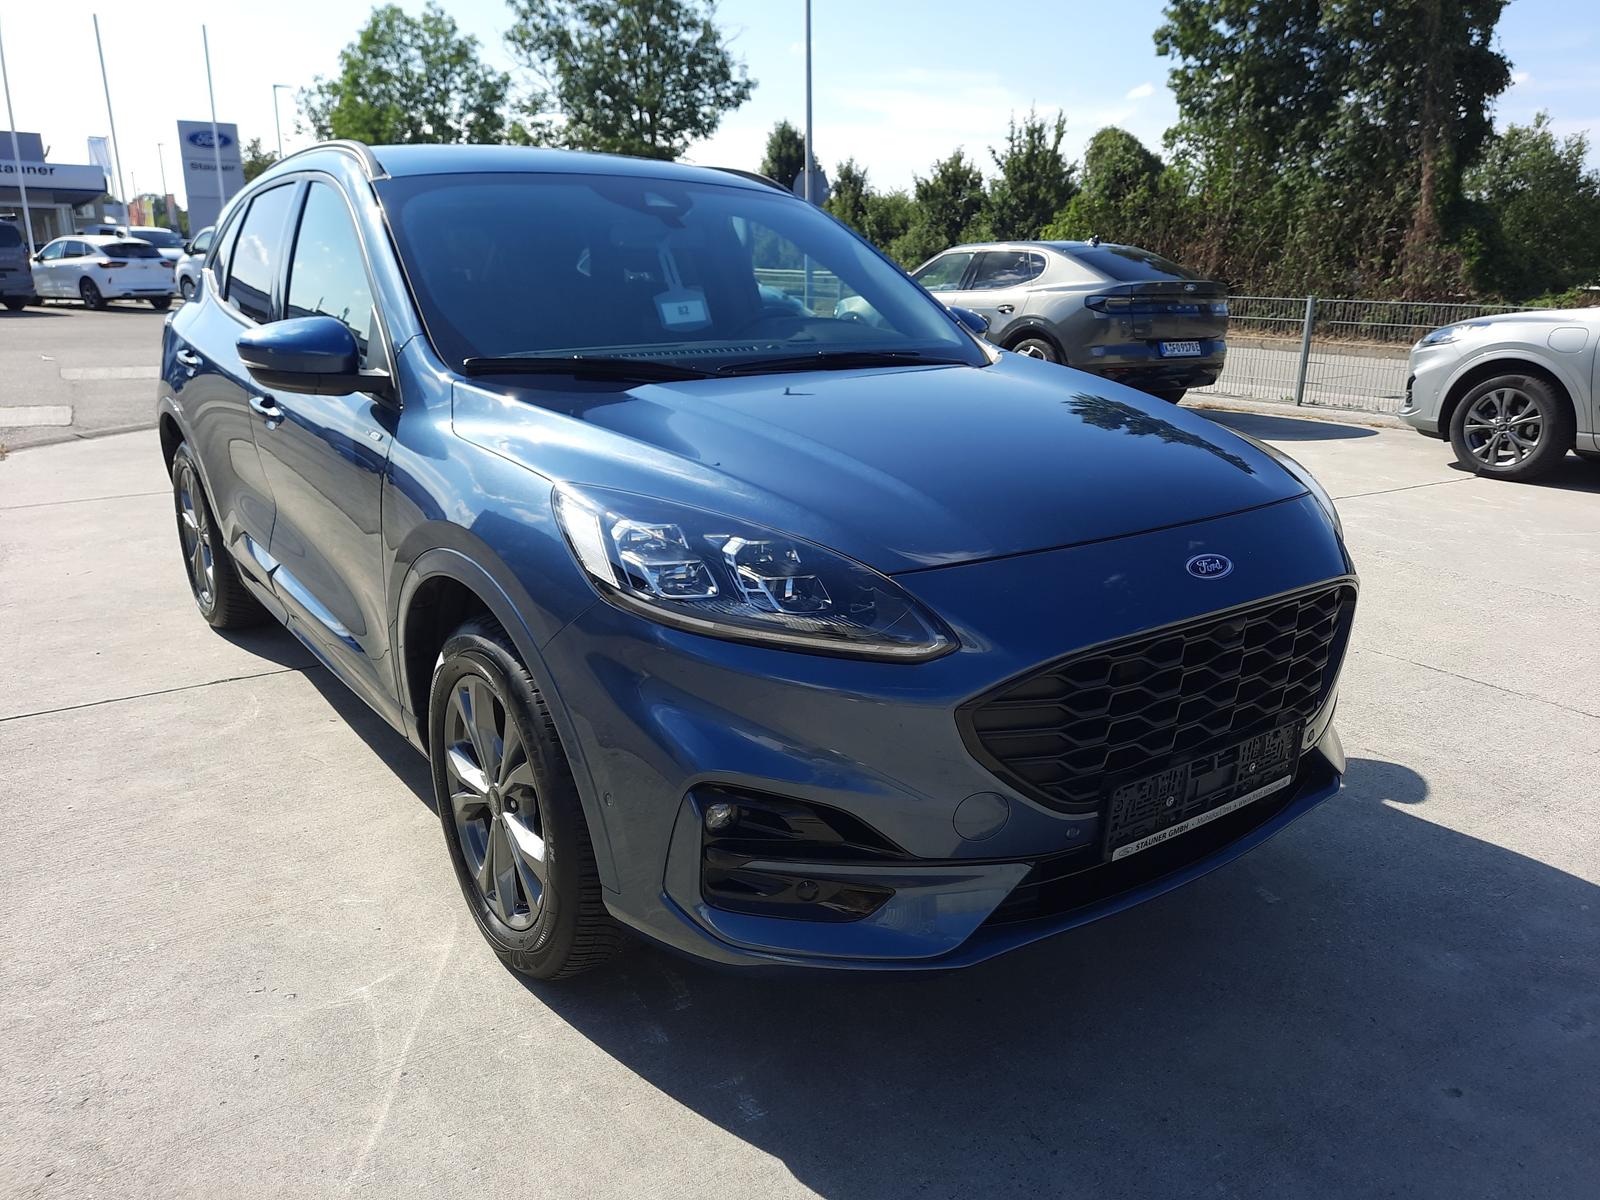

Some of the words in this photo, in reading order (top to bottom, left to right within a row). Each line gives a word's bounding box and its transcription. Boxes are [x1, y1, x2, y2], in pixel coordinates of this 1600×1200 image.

[190, 161, 236, 171] Stauer
[1196, 558, 1223, 574] Ford
[1135, 832, 1167, 851] STAUNER
[1168, 823, 1189, 838] GMBH
